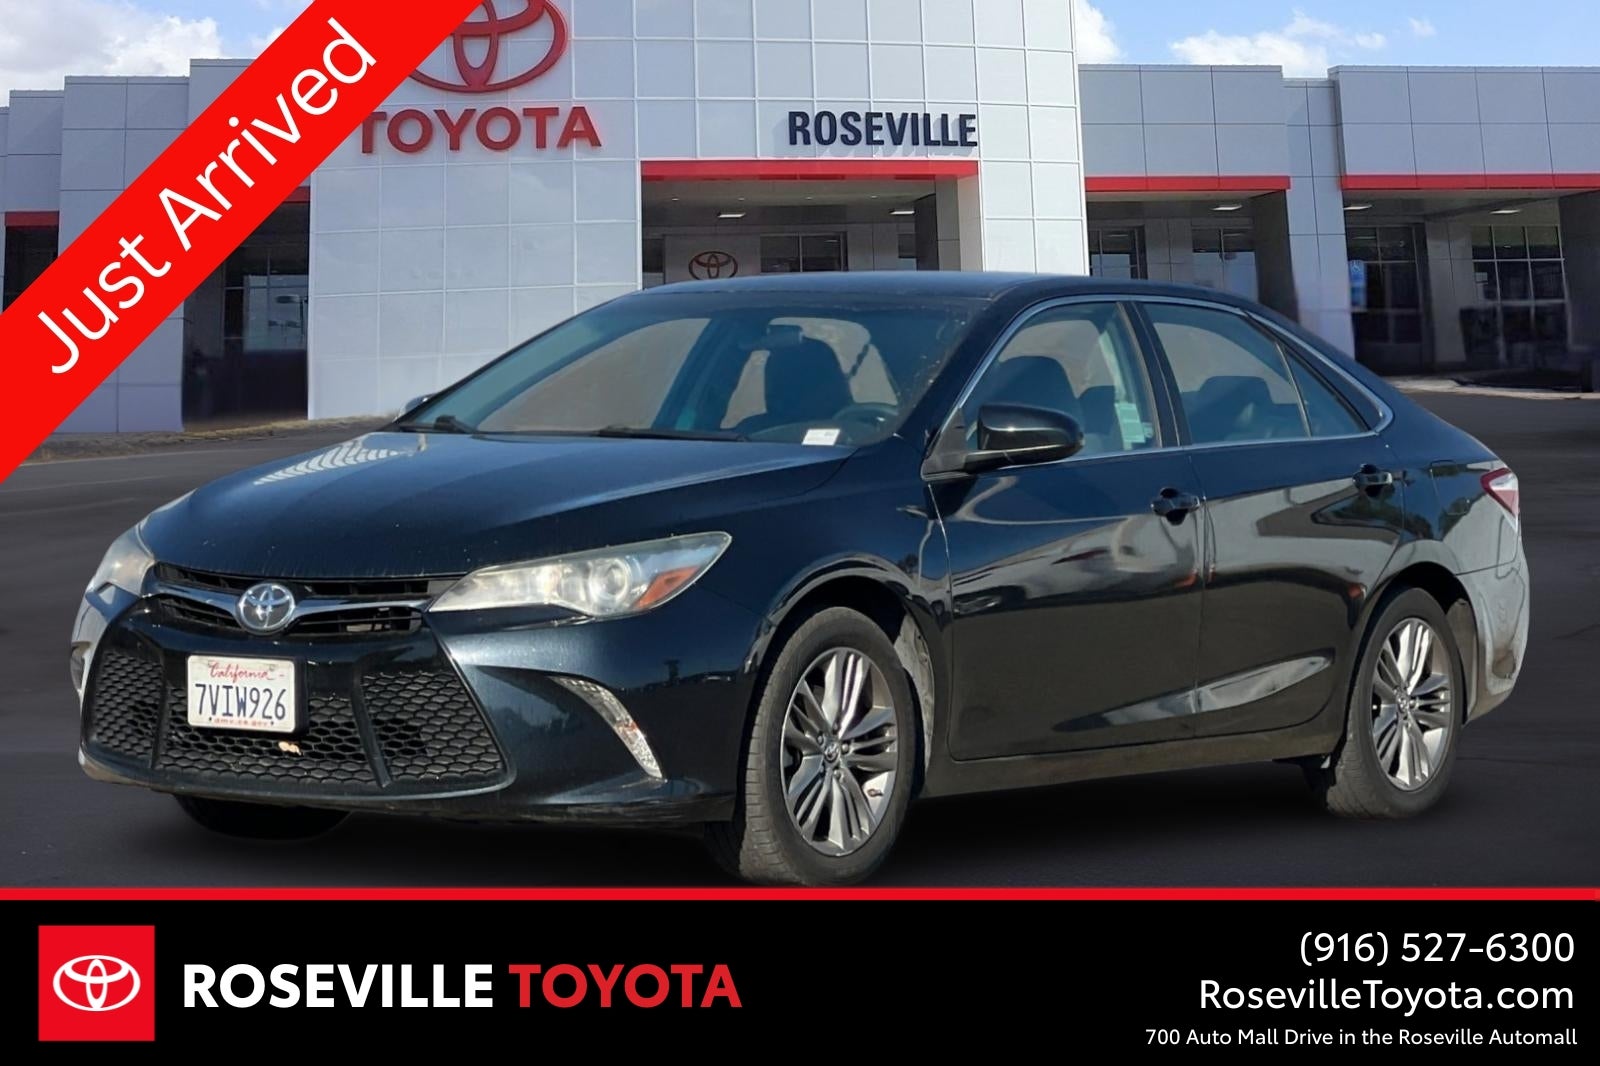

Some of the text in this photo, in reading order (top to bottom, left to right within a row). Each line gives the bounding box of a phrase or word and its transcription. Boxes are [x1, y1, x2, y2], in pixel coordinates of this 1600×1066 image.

[361, 106, 602, 154] TOYOTA
[788, 110, 979, 148] ROSEVILLE
[208, 661, 278, 683] California
[195, 683, 287, 721] 7VIW926
